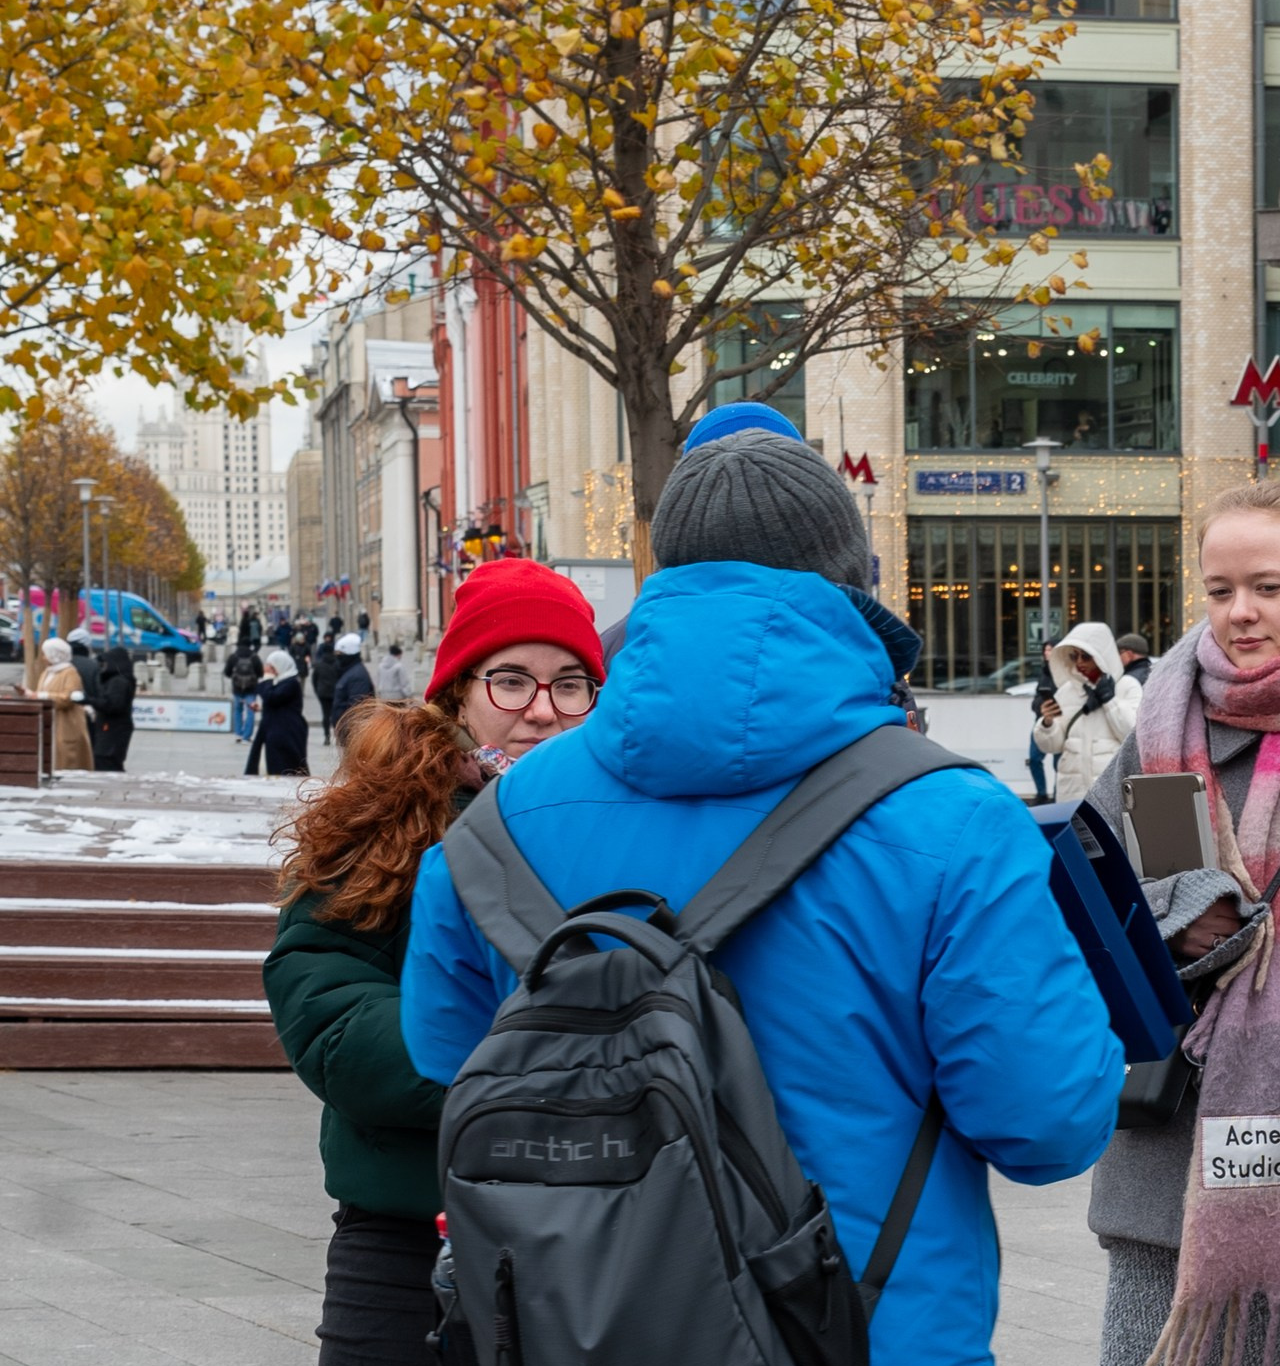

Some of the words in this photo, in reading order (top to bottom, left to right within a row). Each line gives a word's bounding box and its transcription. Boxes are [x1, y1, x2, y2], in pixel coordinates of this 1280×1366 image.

[1006, 371, 1078, 386] CELEBRITY
[1010, 474, 1022, 490] 2
[490, 1135, 593, 1162] arctic
